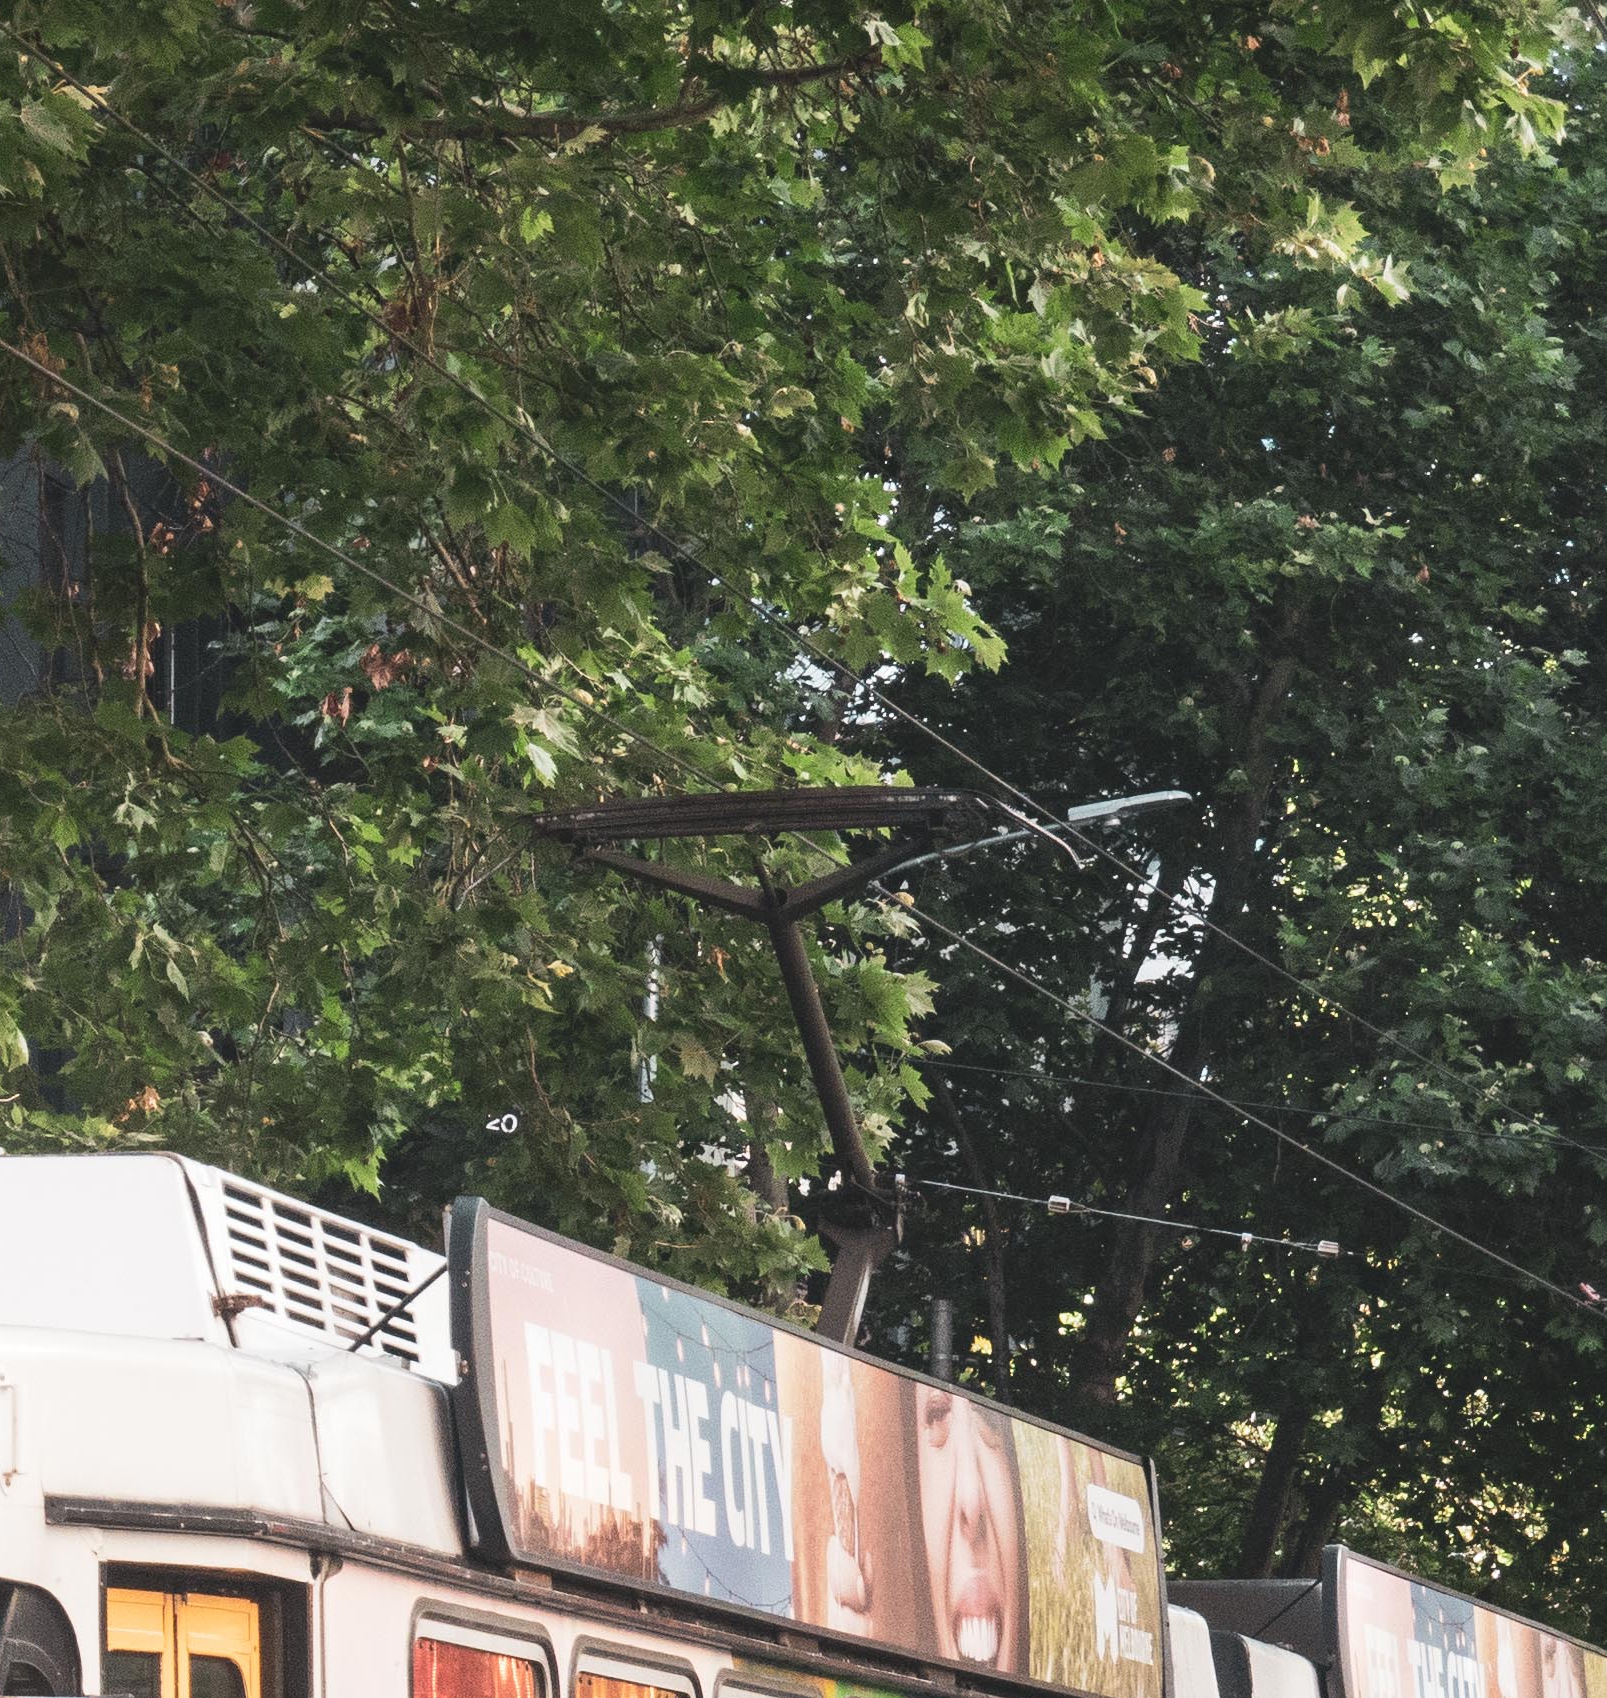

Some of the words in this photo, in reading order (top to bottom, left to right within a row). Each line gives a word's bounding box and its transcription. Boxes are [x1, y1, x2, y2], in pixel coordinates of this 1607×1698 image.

[524, 1320, 633, 1513] FEEL
[633, 1359, 717, 1538] THE
[720, 1389, 795, 1562] CITY
